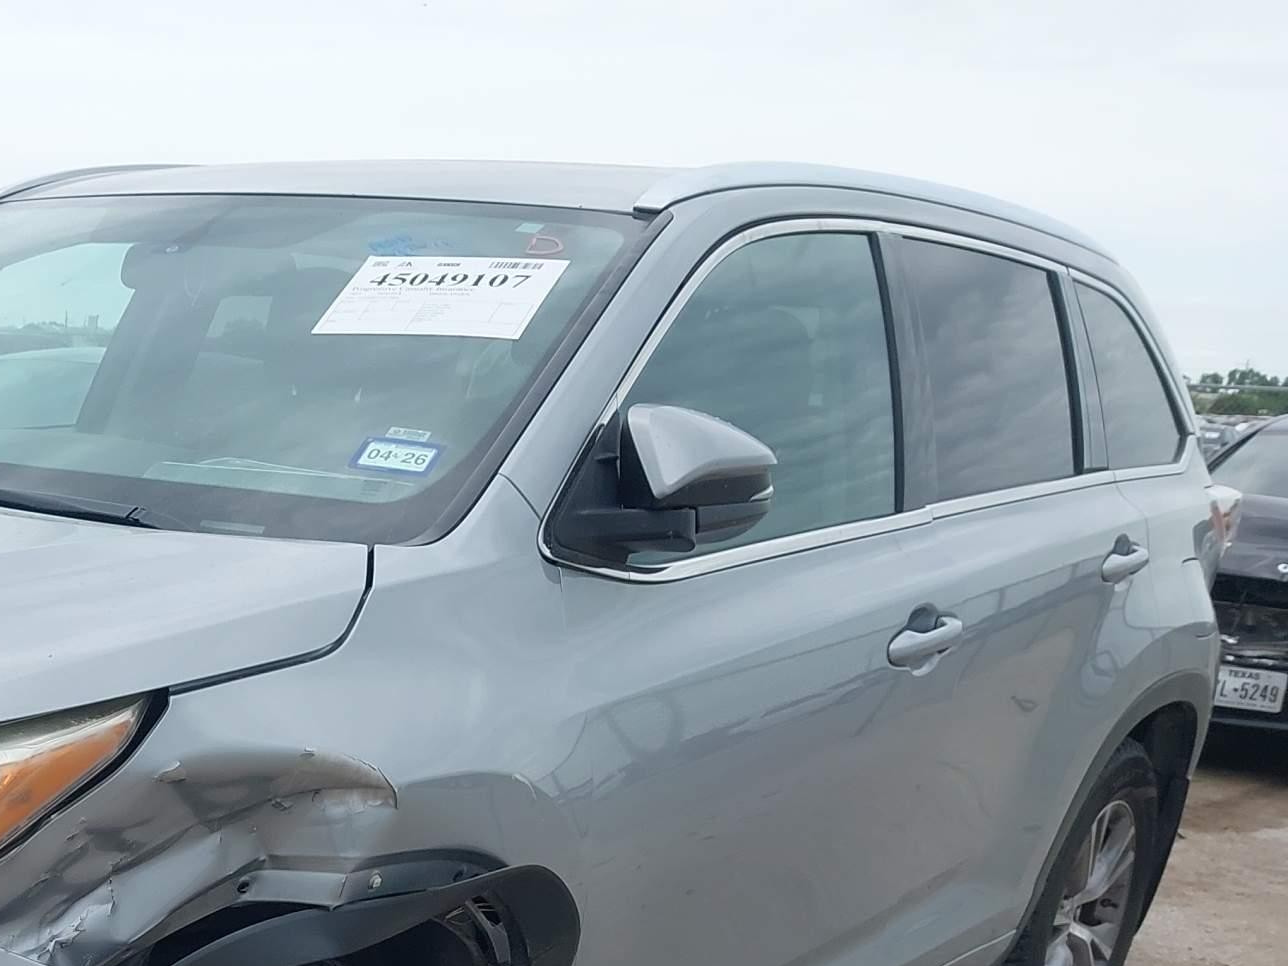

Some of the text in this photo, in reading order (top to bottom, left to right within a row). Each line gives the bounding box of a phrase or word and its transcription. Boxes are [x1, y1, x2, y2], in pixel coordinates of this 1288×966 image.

[369, 272, 531, 288] 45049107
[367, 448, 429, 466] 04 26
[1228, 669, 1261, 680] TEXAS
